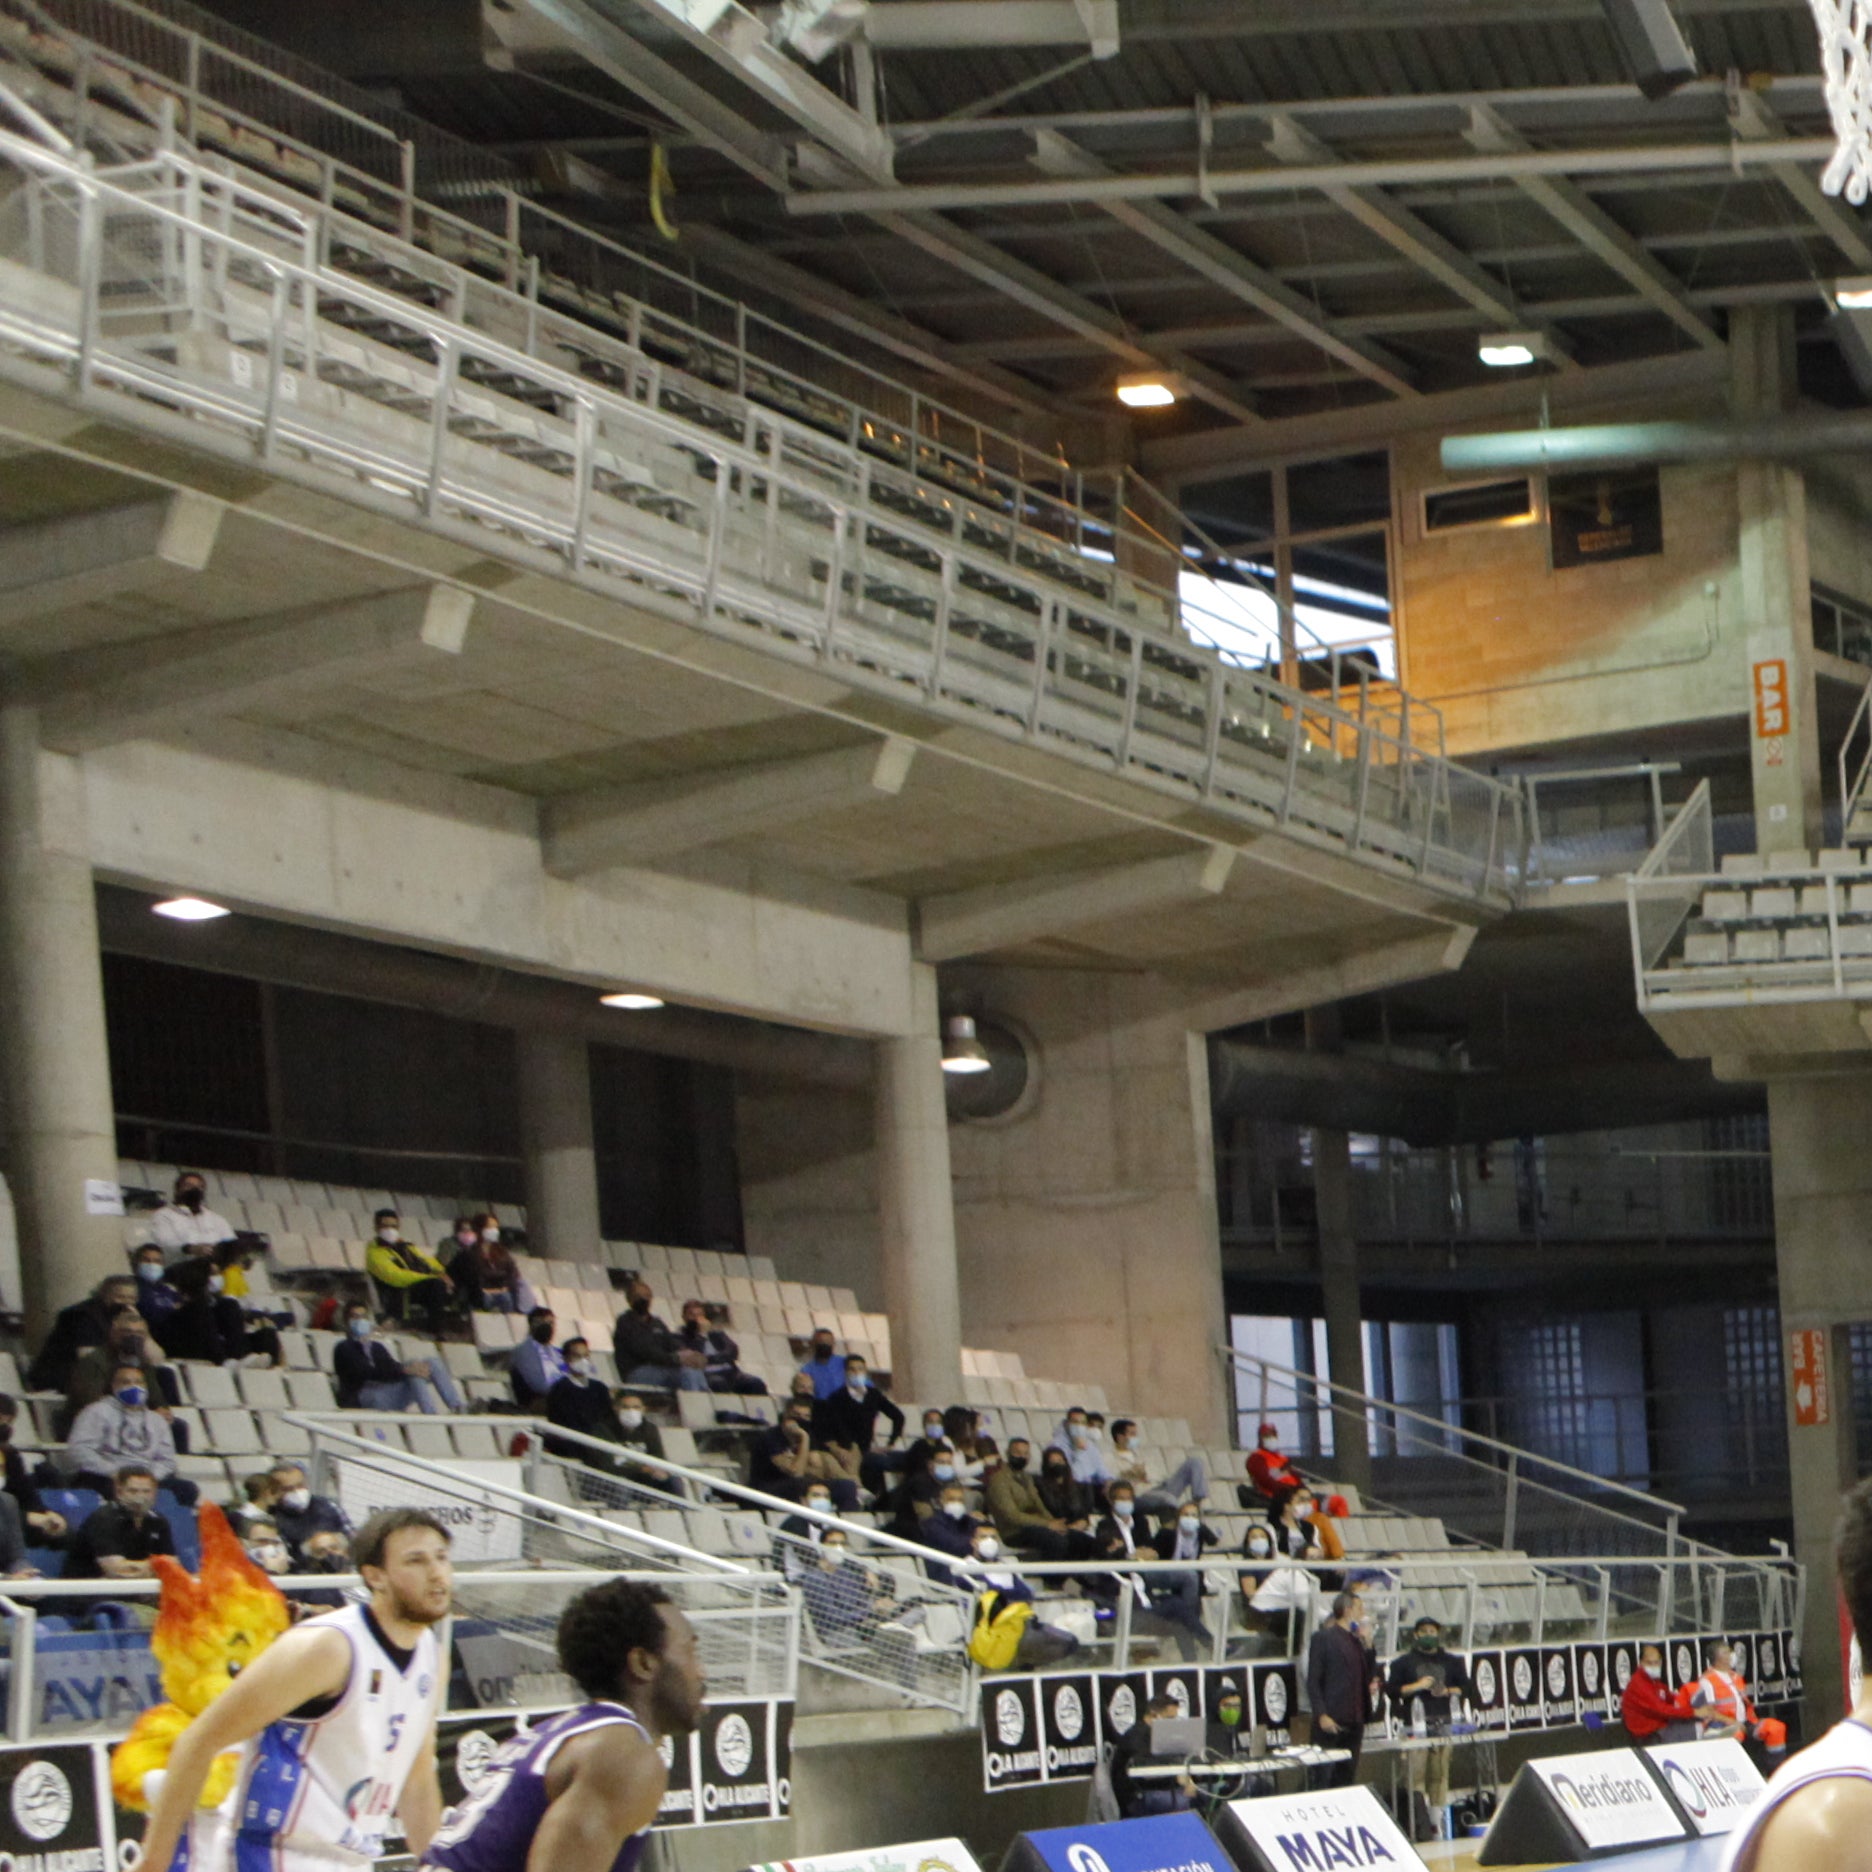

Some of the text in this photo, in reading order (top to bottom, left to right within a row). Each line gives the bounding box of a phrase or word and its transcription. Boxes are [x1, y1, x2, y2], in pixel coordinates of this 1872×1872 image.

[1760, 664, 1784, 732] BAR
[385, 1712, 408, 1753] 5
[1280, 1803, 1347, 1823] HOTEL
